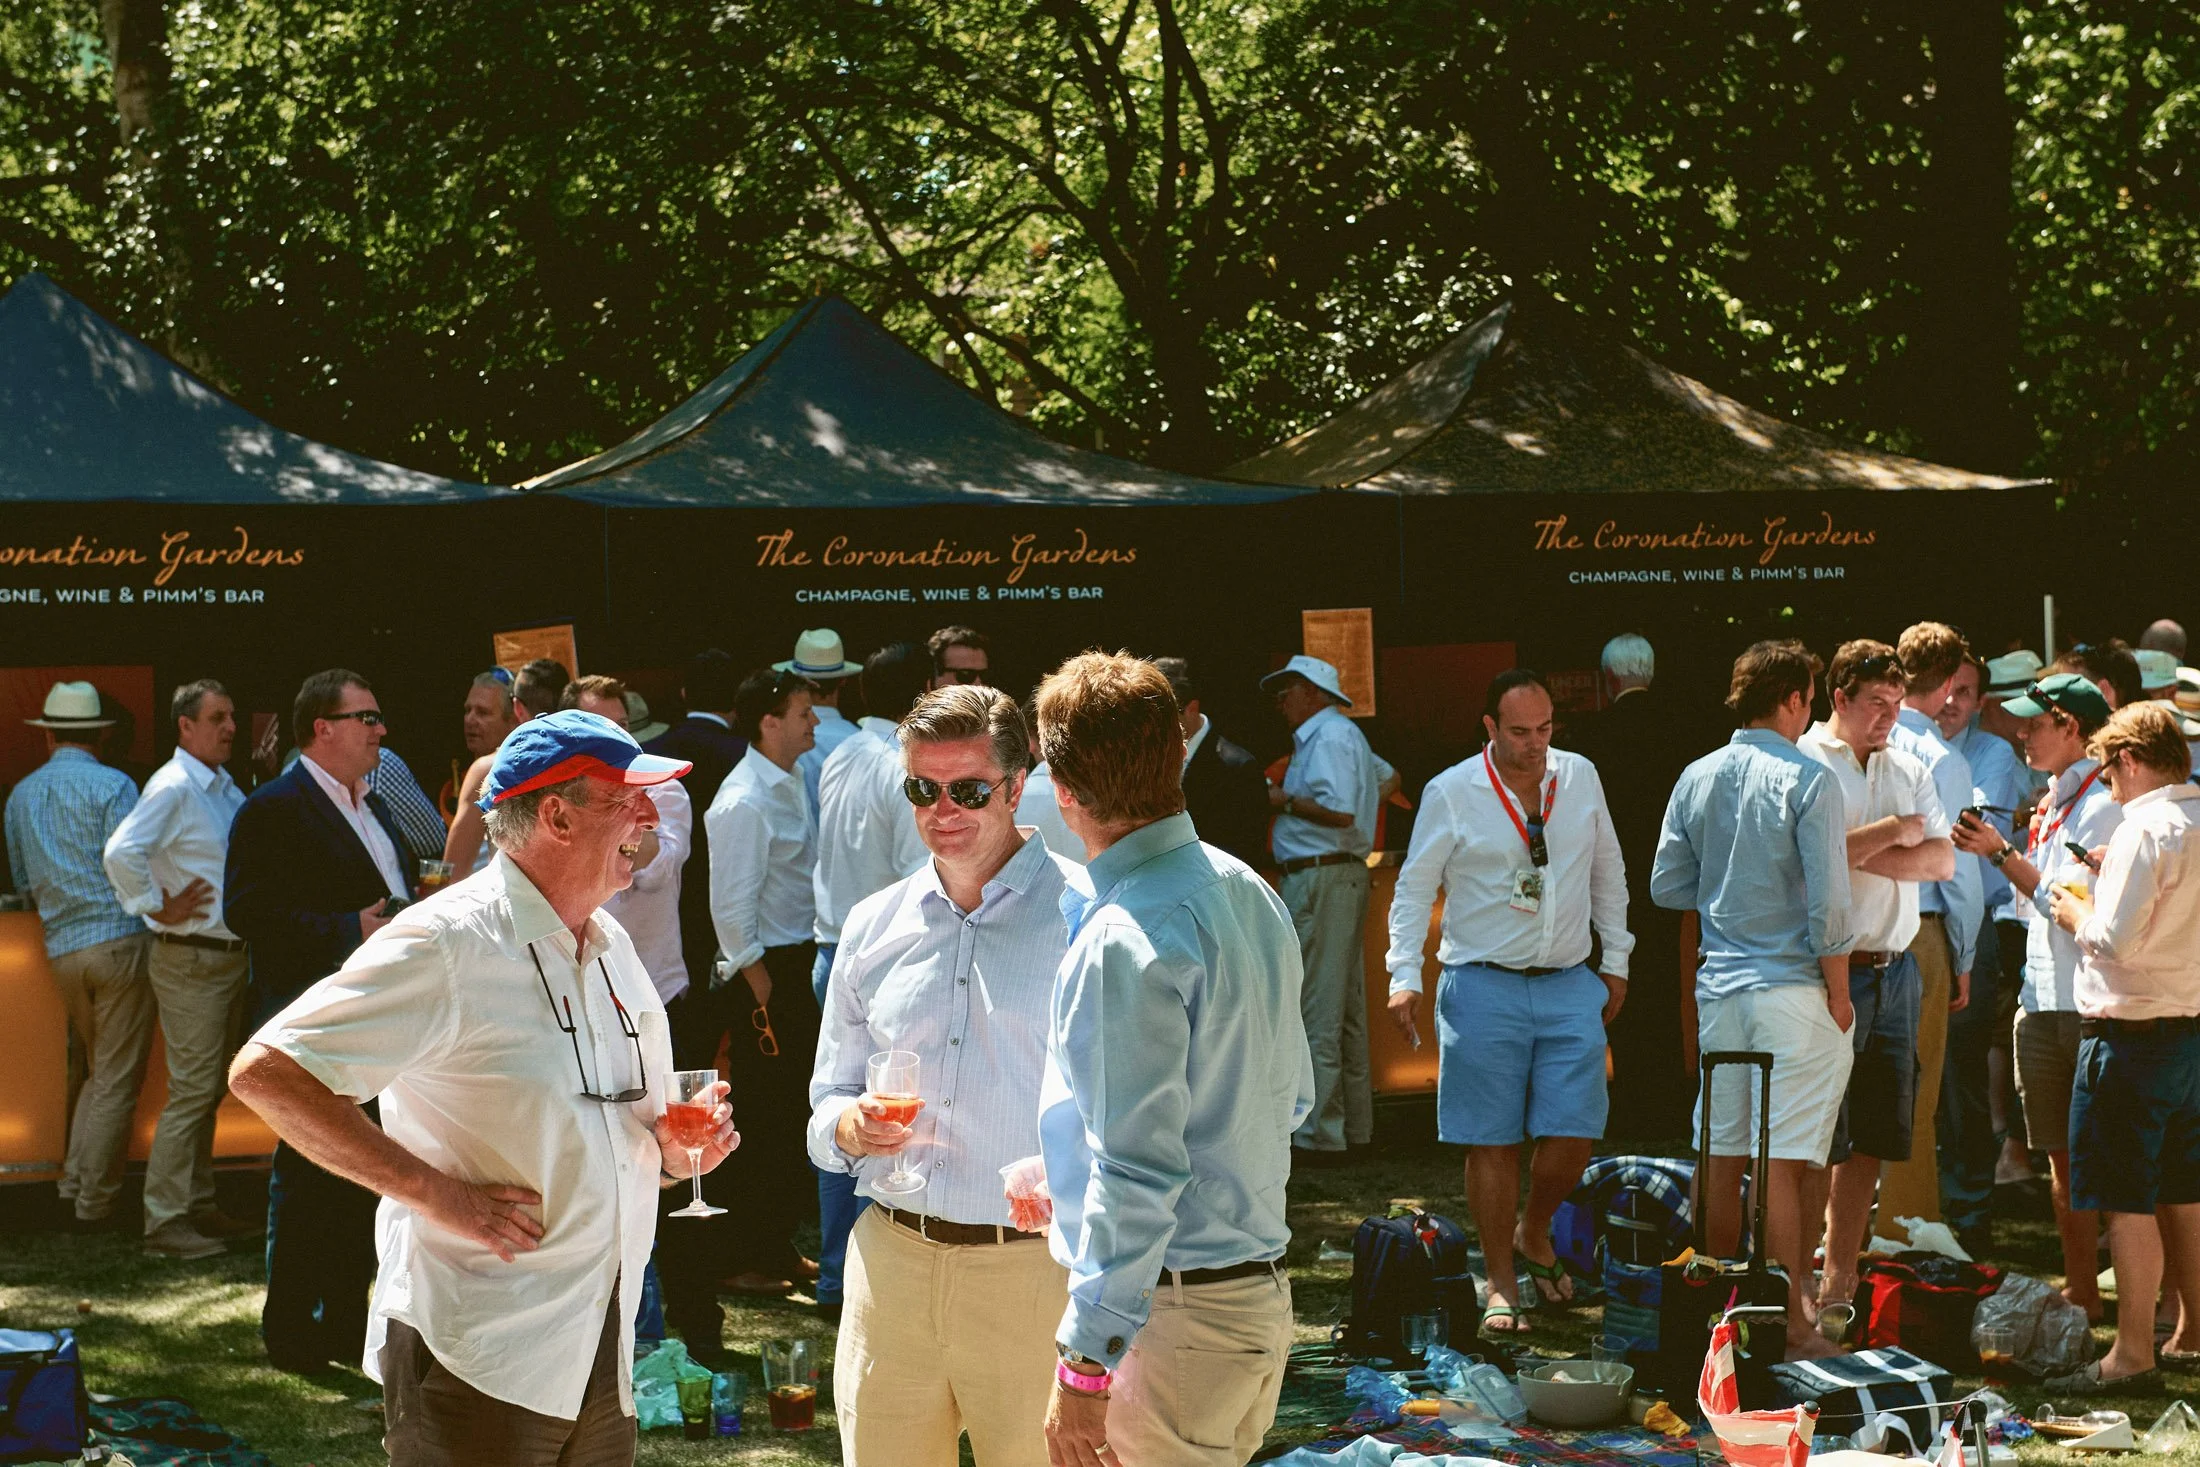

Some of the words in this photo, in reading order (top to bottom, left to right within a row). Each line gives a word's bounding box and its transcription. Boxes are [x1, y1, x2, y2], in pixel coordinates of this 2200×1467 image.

[154, 526, 304, 586] Gardens
[757, 528, 811, 567] The
[823, 535, 1000, 567] Coronation
[1006, 528, 1137, 584] Gardens
[1535, 513, 1584, 550] The
[1594, 520, 1753, 549] Coronation
[1758, 511, 1876, 565] Gardens
[1568, 569, 1677, 584] CHAMPAGNE,
[1683, 568, 1726, 582] WINE
[1731, 566, 1744, 581] &
[1750, 566, 1808, 580] PIMM'S
[1813, 566, 1846, 580] BAR
[56, 589, 110, 603] WINE
[119, 587, 134, 603] &
[143, 587, 217, 603] PIMM'S
[224, 589, 265, 603] BAR
[795, 588, 917, 603] CHAMPAGNE,
[922, 588, 970, 601] WINE
[976, 585, 990, 601] &
[997, 584, 1062, 600] PIMM'S
[1068, 586, 1104, 600] BAR
